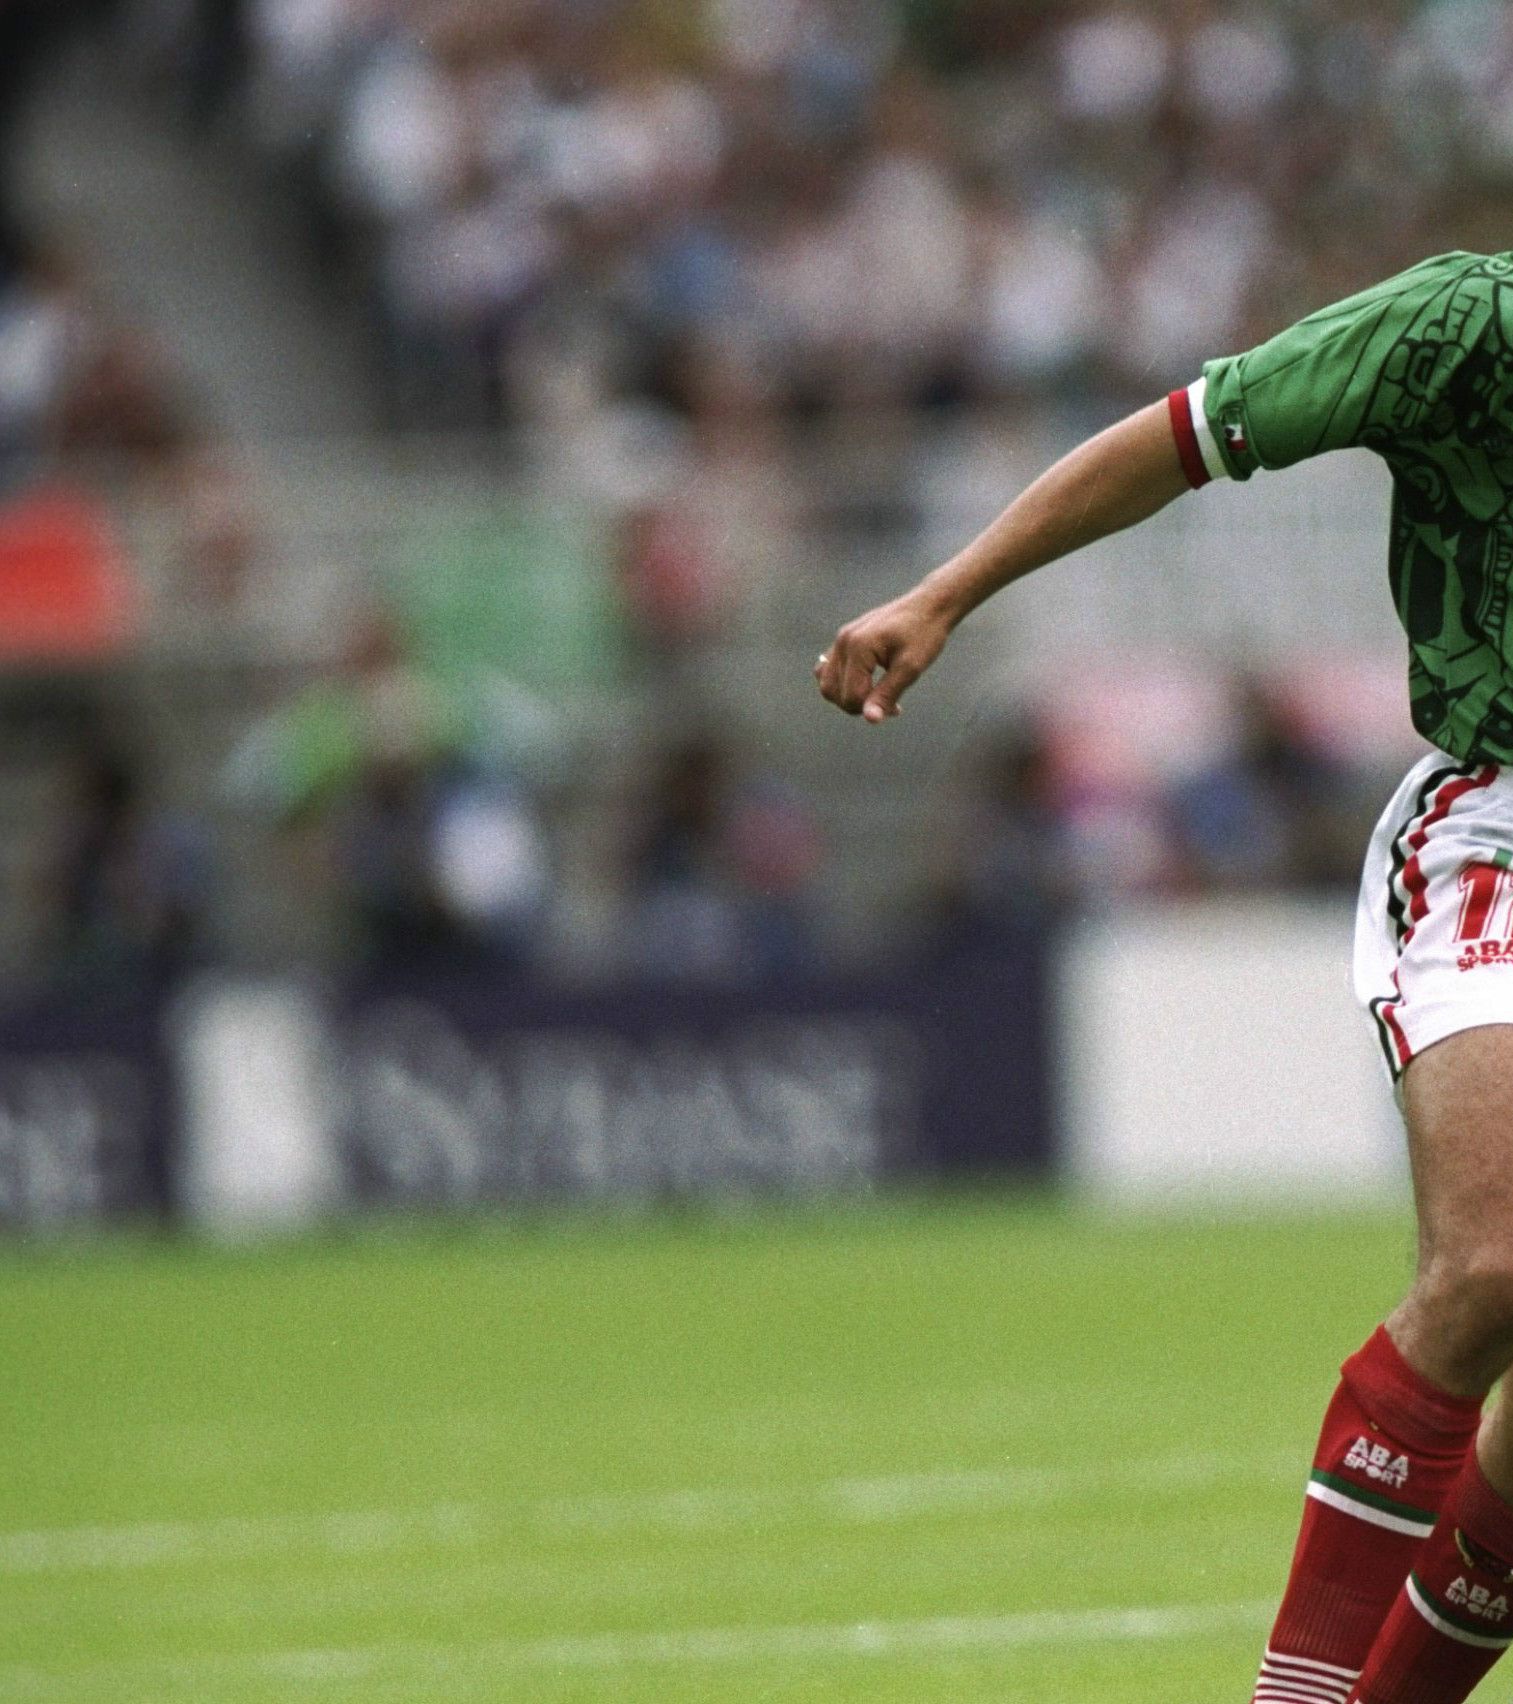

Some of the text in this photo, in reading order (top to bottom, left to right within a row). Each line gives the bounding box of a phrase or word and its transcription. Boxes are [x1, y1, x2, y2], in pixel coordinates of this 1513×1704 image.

[1343, 1452, 1407, 1488] SPORT
[1350, 1436, 1408, 1476] ABA
[1444, 1587, 1505, 1621] SPORT
[1450, 1576, 1508, 1612] ABA
